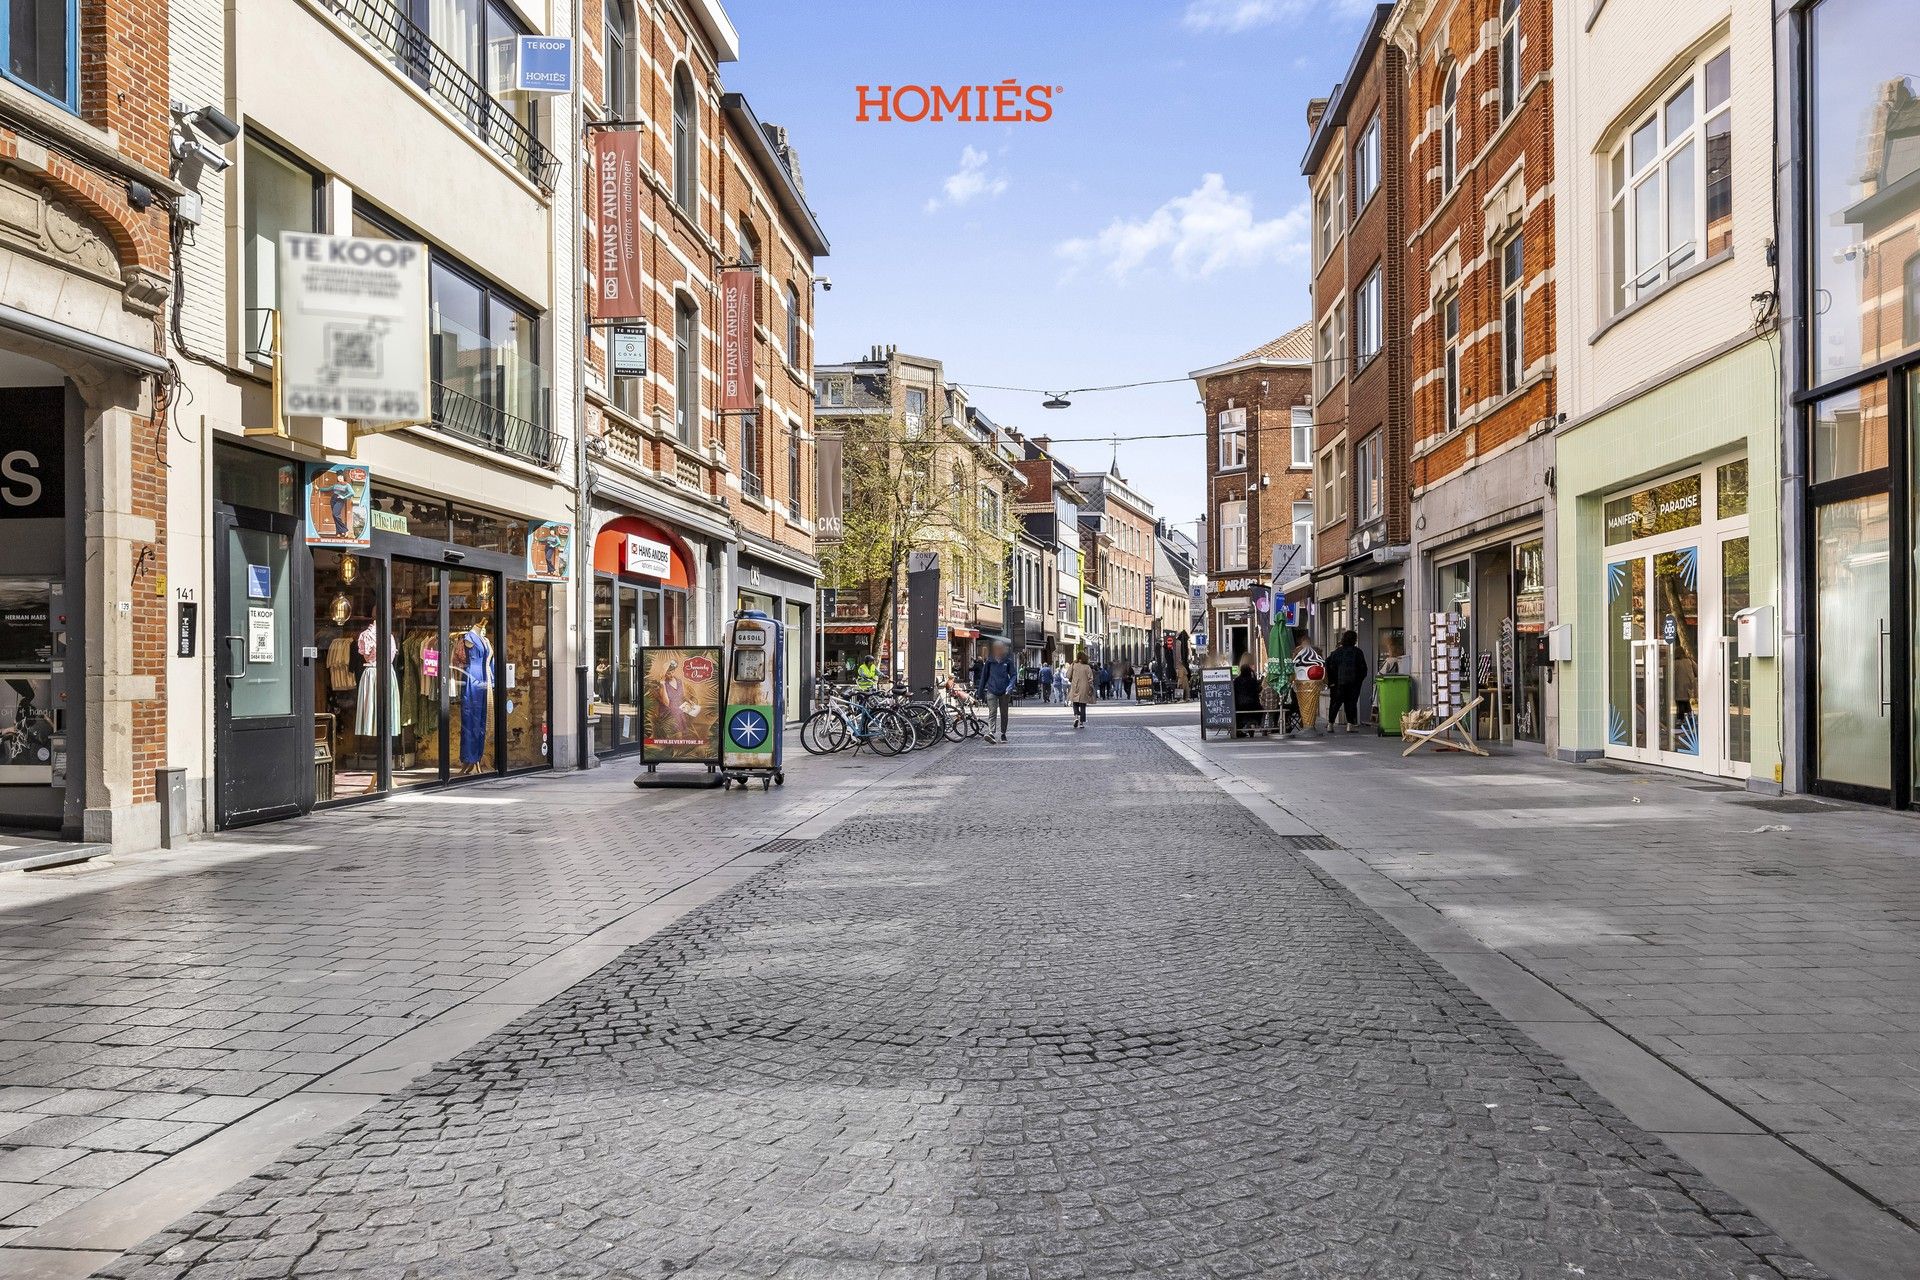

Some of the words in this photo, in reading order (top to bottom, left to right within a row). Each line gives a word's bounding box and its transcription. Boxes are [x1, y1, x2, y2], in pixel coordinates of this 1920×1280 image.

[526, 41, 538, 50] TE
[539, 42, 566, 51] KOOP
[602, 151, 617, 220] ANDERS
[622, 160, 633, 213] audiologen
[288, 236, 321, 262] TE
[329, 241, 416, 269] KOOP
[604, 223, 618, 272] HANS
[623, 217, 633, 260] opticiens
[726, 287, 738, 337] ANDERS
[726, 340, 738, 376] HANS
[1, 450, 42, 507] S
[819, 517, 841, 531] CKS
[1608, 511, 1641, 529] MANIFEST
[1660, 494, 1698, 515] PARADISE
[638, 545, 652, 558] HANS
[651, 549, 669, 563] ANDERS
[176, 587, 194, 601] 141
[250, 610, 257, 618] TE
[424, 658, 438, 667] OPEN
